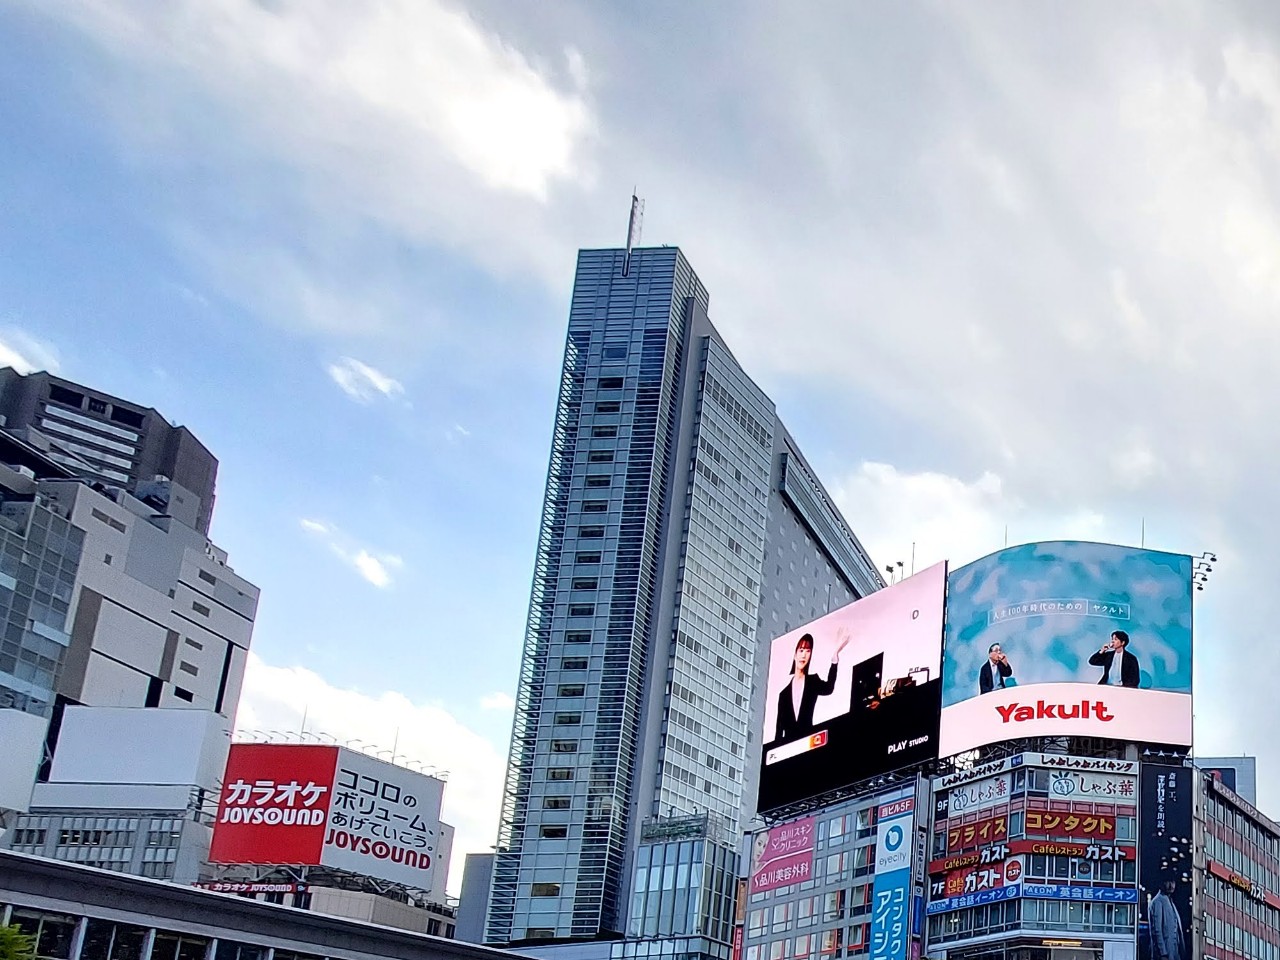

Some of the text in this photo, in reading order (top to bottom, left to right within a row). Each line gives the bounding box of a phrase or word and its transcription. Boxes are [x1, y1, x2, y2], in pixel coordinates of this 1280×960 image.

[1092, 604, 1124, 615] ヤクルト
[995, 699, 1115, 724] Yakult
[887, 735, 929, 755] PLAY STUDIO
[1041, 755, 1134, 771] しゃぶしゃぶバイキング
[942, 760, 1005, 787] しゃぶしゃぶバイキング
[224, 779, 328, 808] カラオケ
[338, 768, 417, 808] ココロの
[970, 779, 1007, 803] しゃぶ葉
[1079, 776, 1134, 796] しゃぶ葉
[334, 791, 434, 836] ボリューム、
[937, 800, 948, 811] 9F
[220, 808, 325, 826] JOYSOUND
[1026, 813, 1113, 834] コンタクト
[331, 811, 433, 852] あげていこう。
[780, 824, 813, 842] 品川スキン
[950, 819, 1006, 847] プライス
[325, 828, 431, 871] JOYSOUND
[779, 838, 808, 852] クリニック
[981, 844, 1010, 865] ガスト
[1085, 845, 1126, 861] ガスト
[879, 852, 907, 866] eyecity
[759, 862, 809, 887] 品川美容外科
[964, 868, 1001, 892] ガスト
[932, 881, 946, 894] 7F
[1060, 887, 1135, 900] 英会話イーオン
[951, 889, 1004, 908] 英会話イーオン
